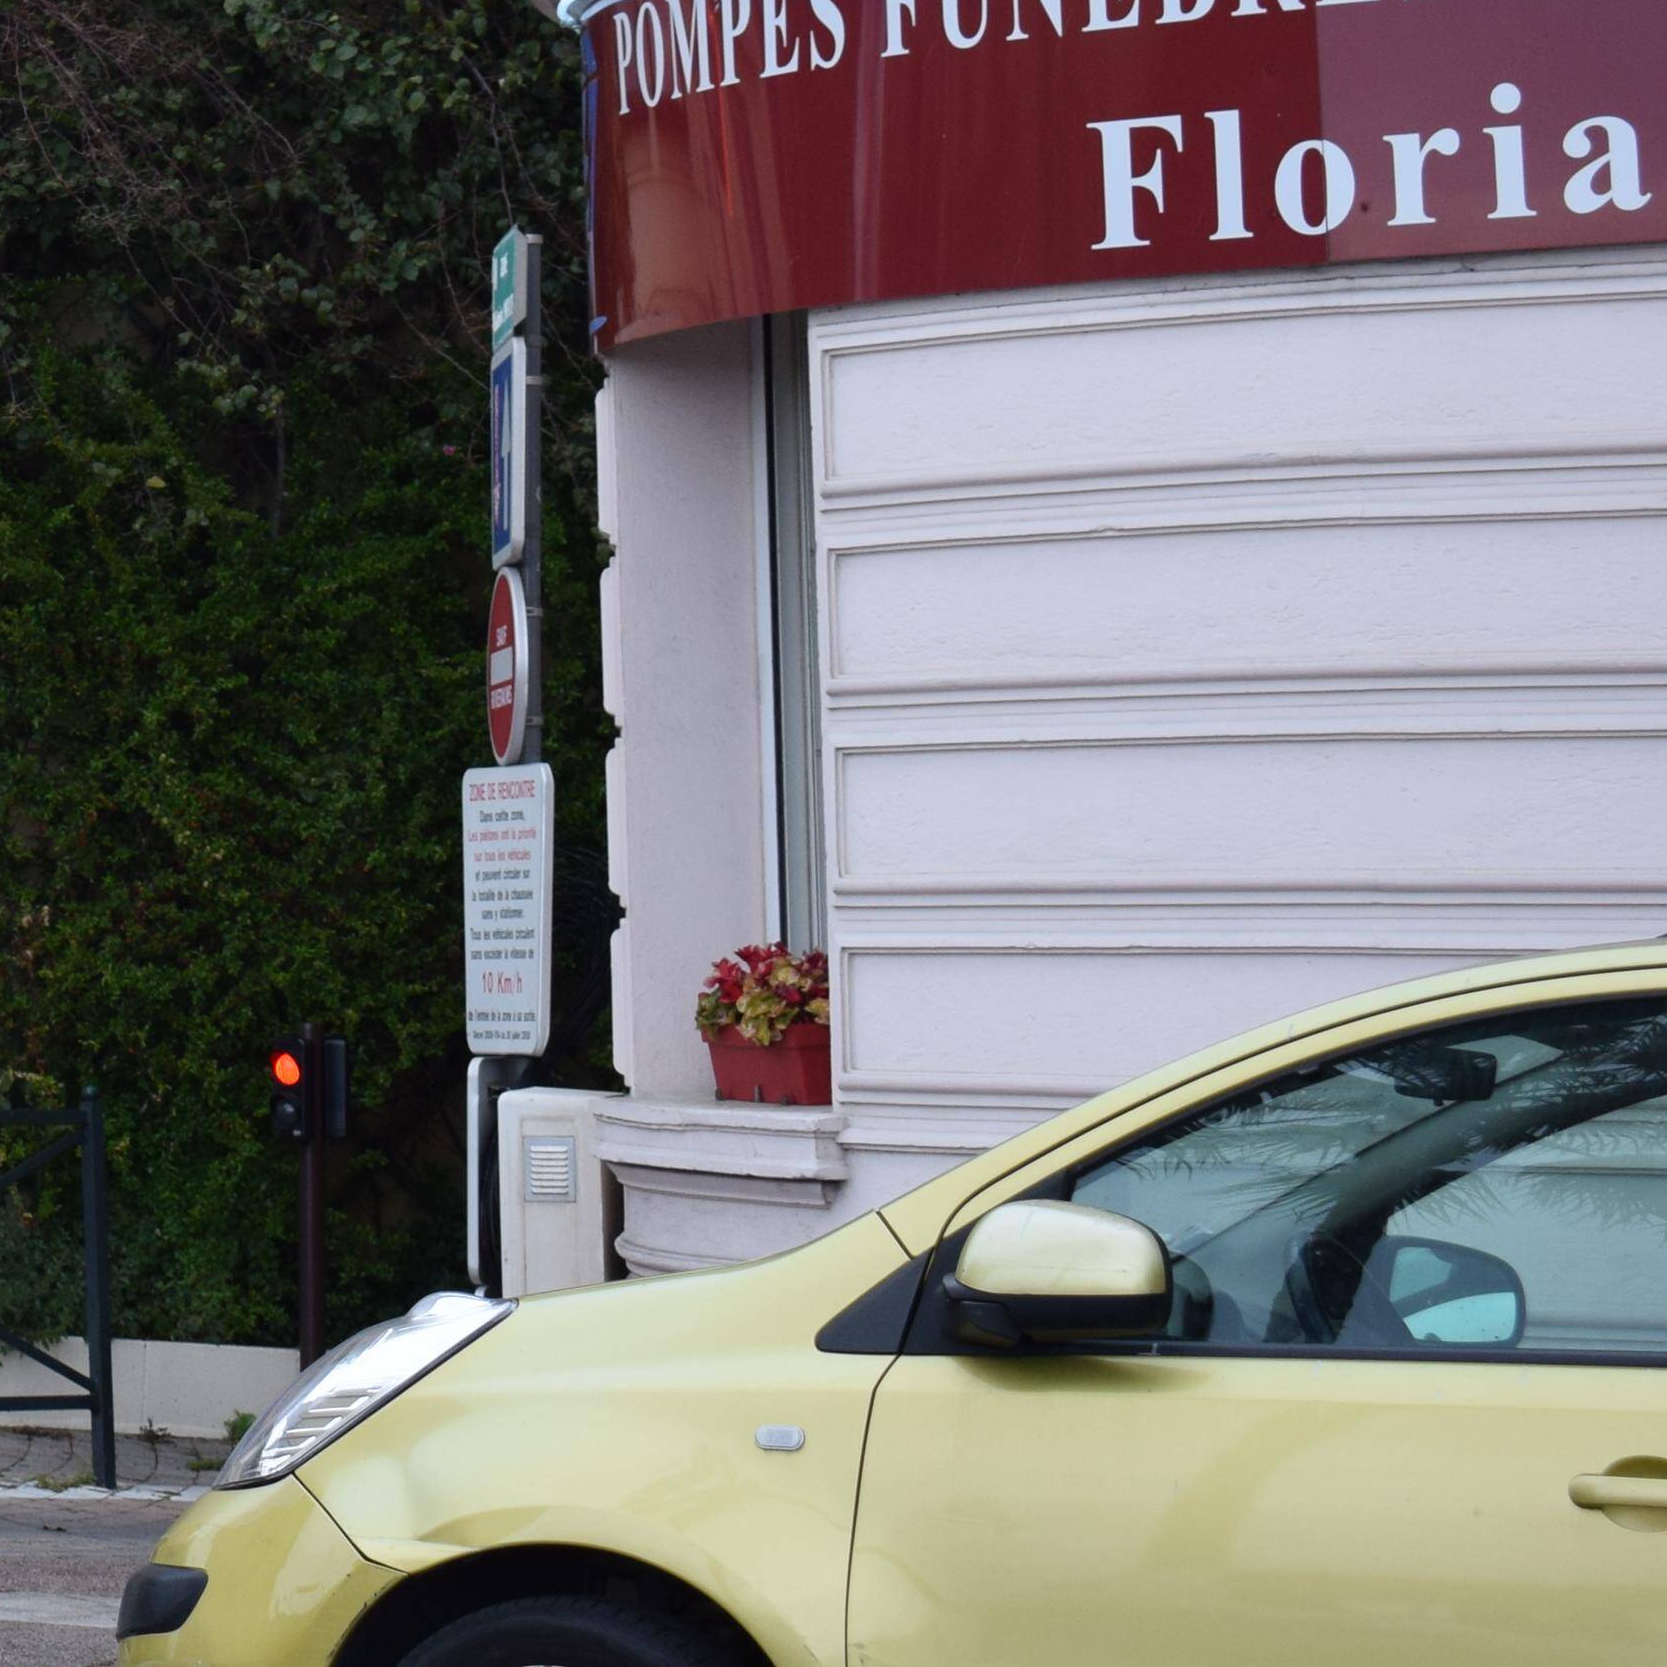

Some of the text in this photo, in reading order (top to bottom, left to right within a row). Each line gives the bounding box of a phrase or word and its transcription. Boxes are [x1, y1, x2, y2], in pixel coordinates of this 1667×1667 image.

[469, 780, 535, 801] ZONE DE RENCONTRE
[482, 971, 523, 994] 10 Km/h
